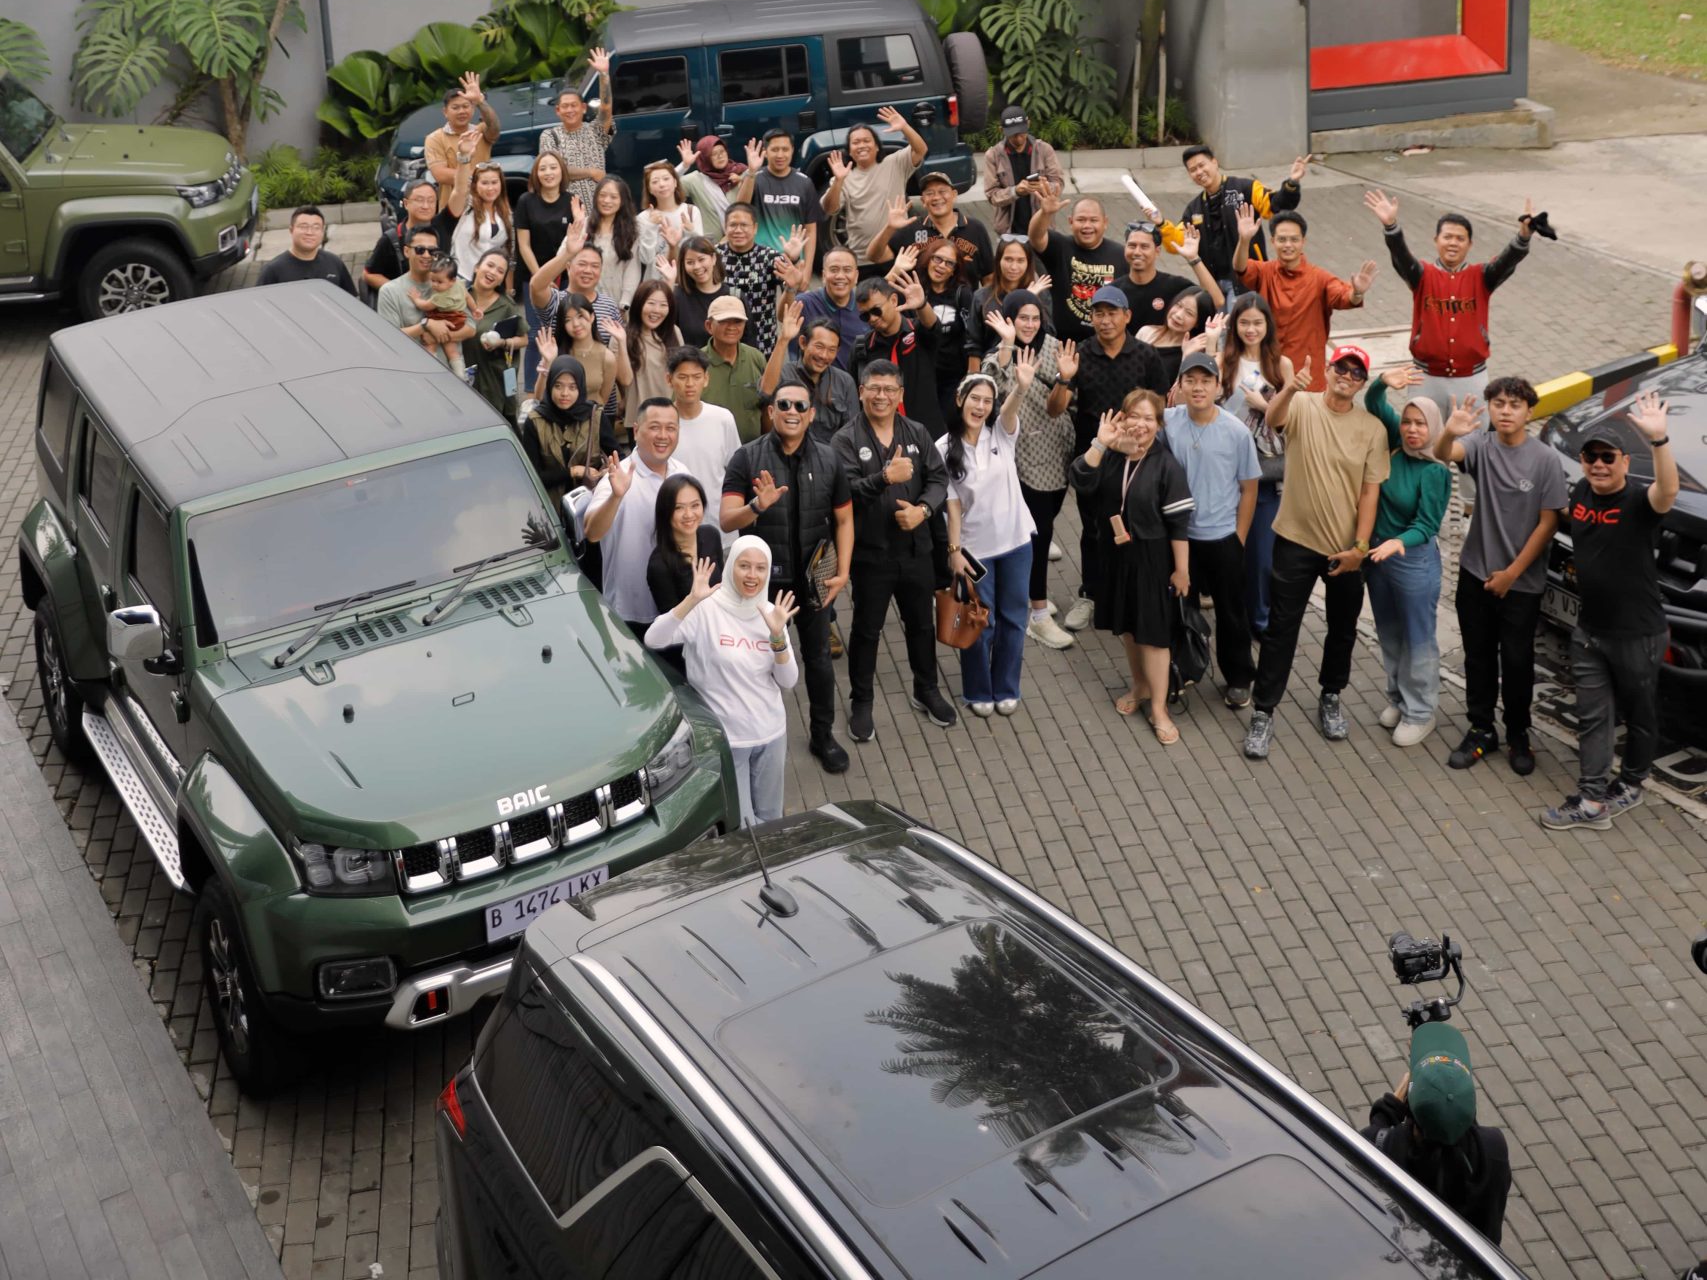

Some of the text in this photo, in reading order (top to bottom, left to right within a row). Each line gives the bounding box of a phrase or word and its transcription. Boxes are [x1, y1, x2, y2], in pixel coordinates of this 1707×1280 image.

[763, 194, 801, 205] BJ30
[914, 229, 928, 243] 88
[1573, 503, 1622, 524] BAIC
[719, 634, 770, 652] BAIC
[497, 784, 551, 816] BAIC
[490, 908, 503, 929] B
